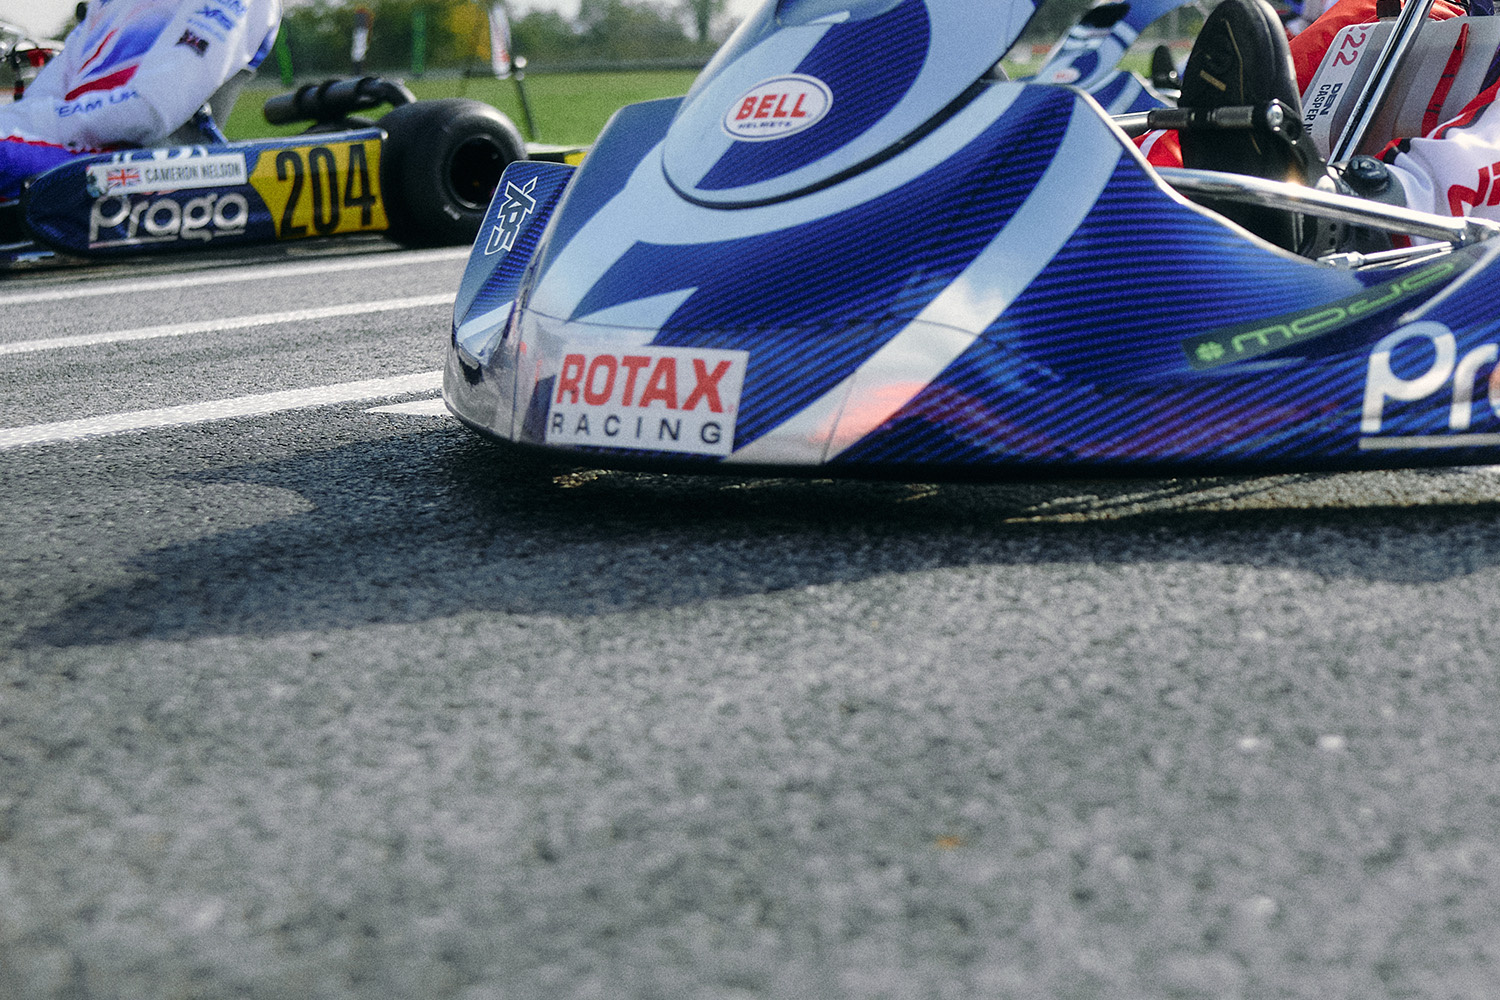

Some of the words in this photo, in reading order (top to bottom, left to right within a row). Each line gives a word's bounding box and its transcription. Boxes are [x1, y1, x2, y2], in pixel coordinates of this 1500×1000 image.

[735, 93, 807, 121] BELL
[1304, 84, 1332, 121] CASPER
[1319, 82, 1343, 116] DEN
[145, 166, 198, 184] CAMERON
[200, 162, 241, 179] NELSON
[276, 144, 377, 239] 204
[485, 176, 538, 256] XPS
[556, 353, 733, 414] ROTAX
[551, 412, 722, 445] RACING
